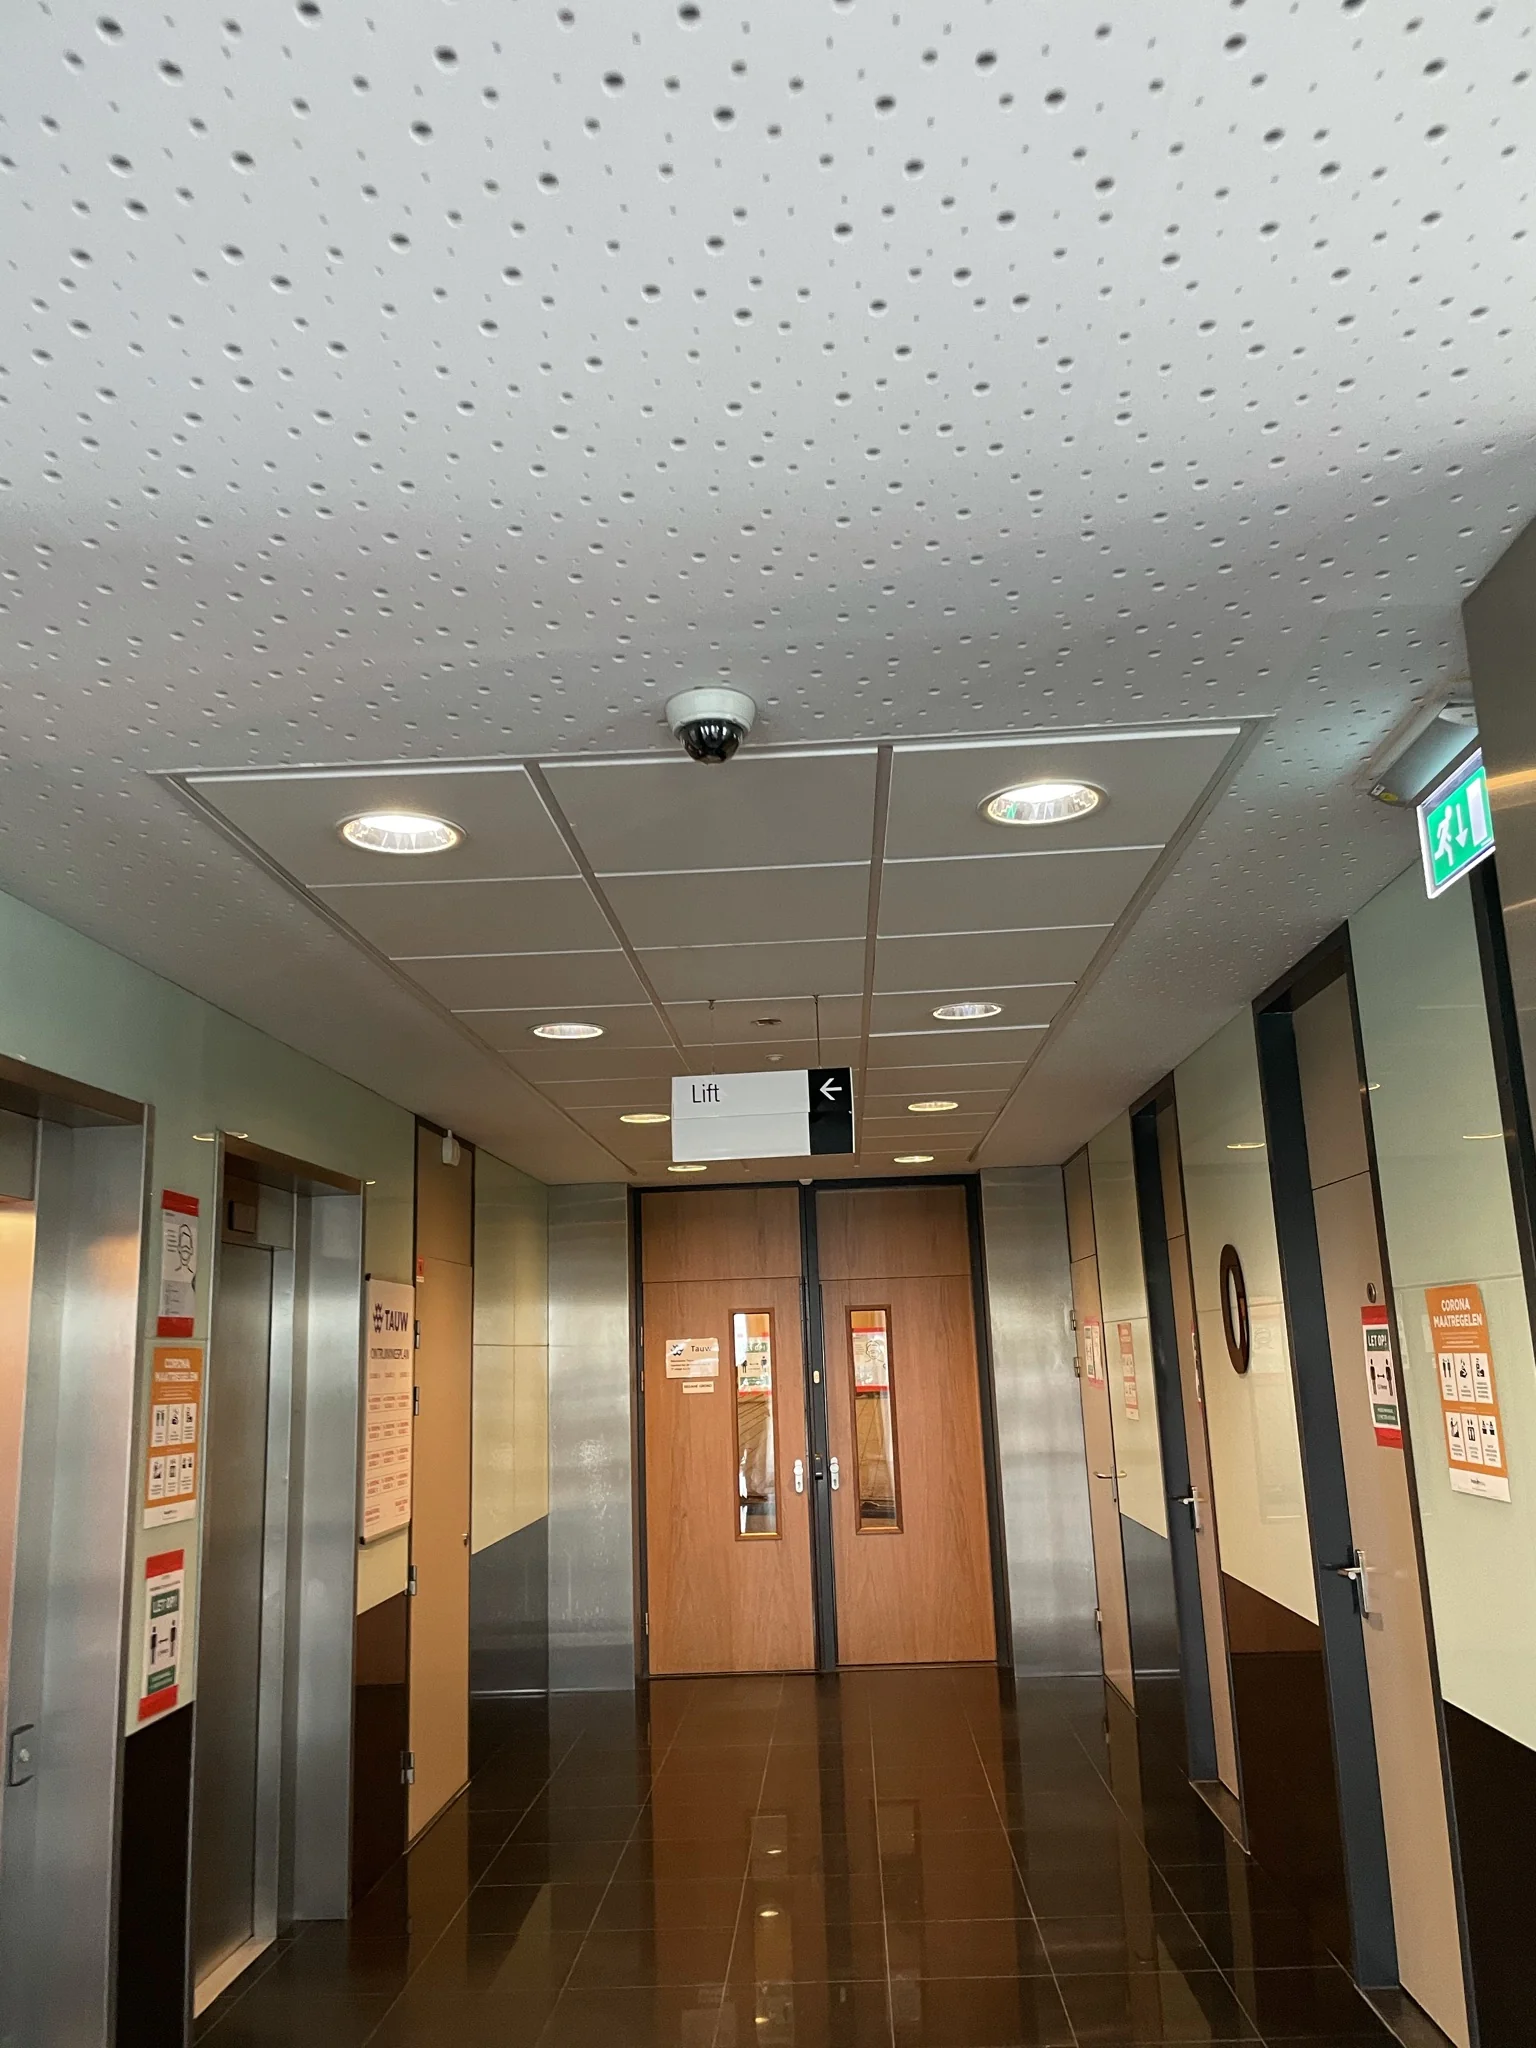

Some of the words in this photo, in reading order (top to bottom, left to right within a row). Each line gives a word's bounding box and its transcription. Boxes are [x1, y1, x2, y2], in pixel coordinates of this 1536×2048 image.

[691, 1083, 720, 1103] Lift
[1441, 1298, 1471, 1312] CORONA
[385, 1310, 409, 1332] TAUW
[1433, 1313, 1483, 1328] MAATREGELEN
[1368, 1335, 1377, 1346] LET
[1377, 1334, 1387, 1346] OP!
